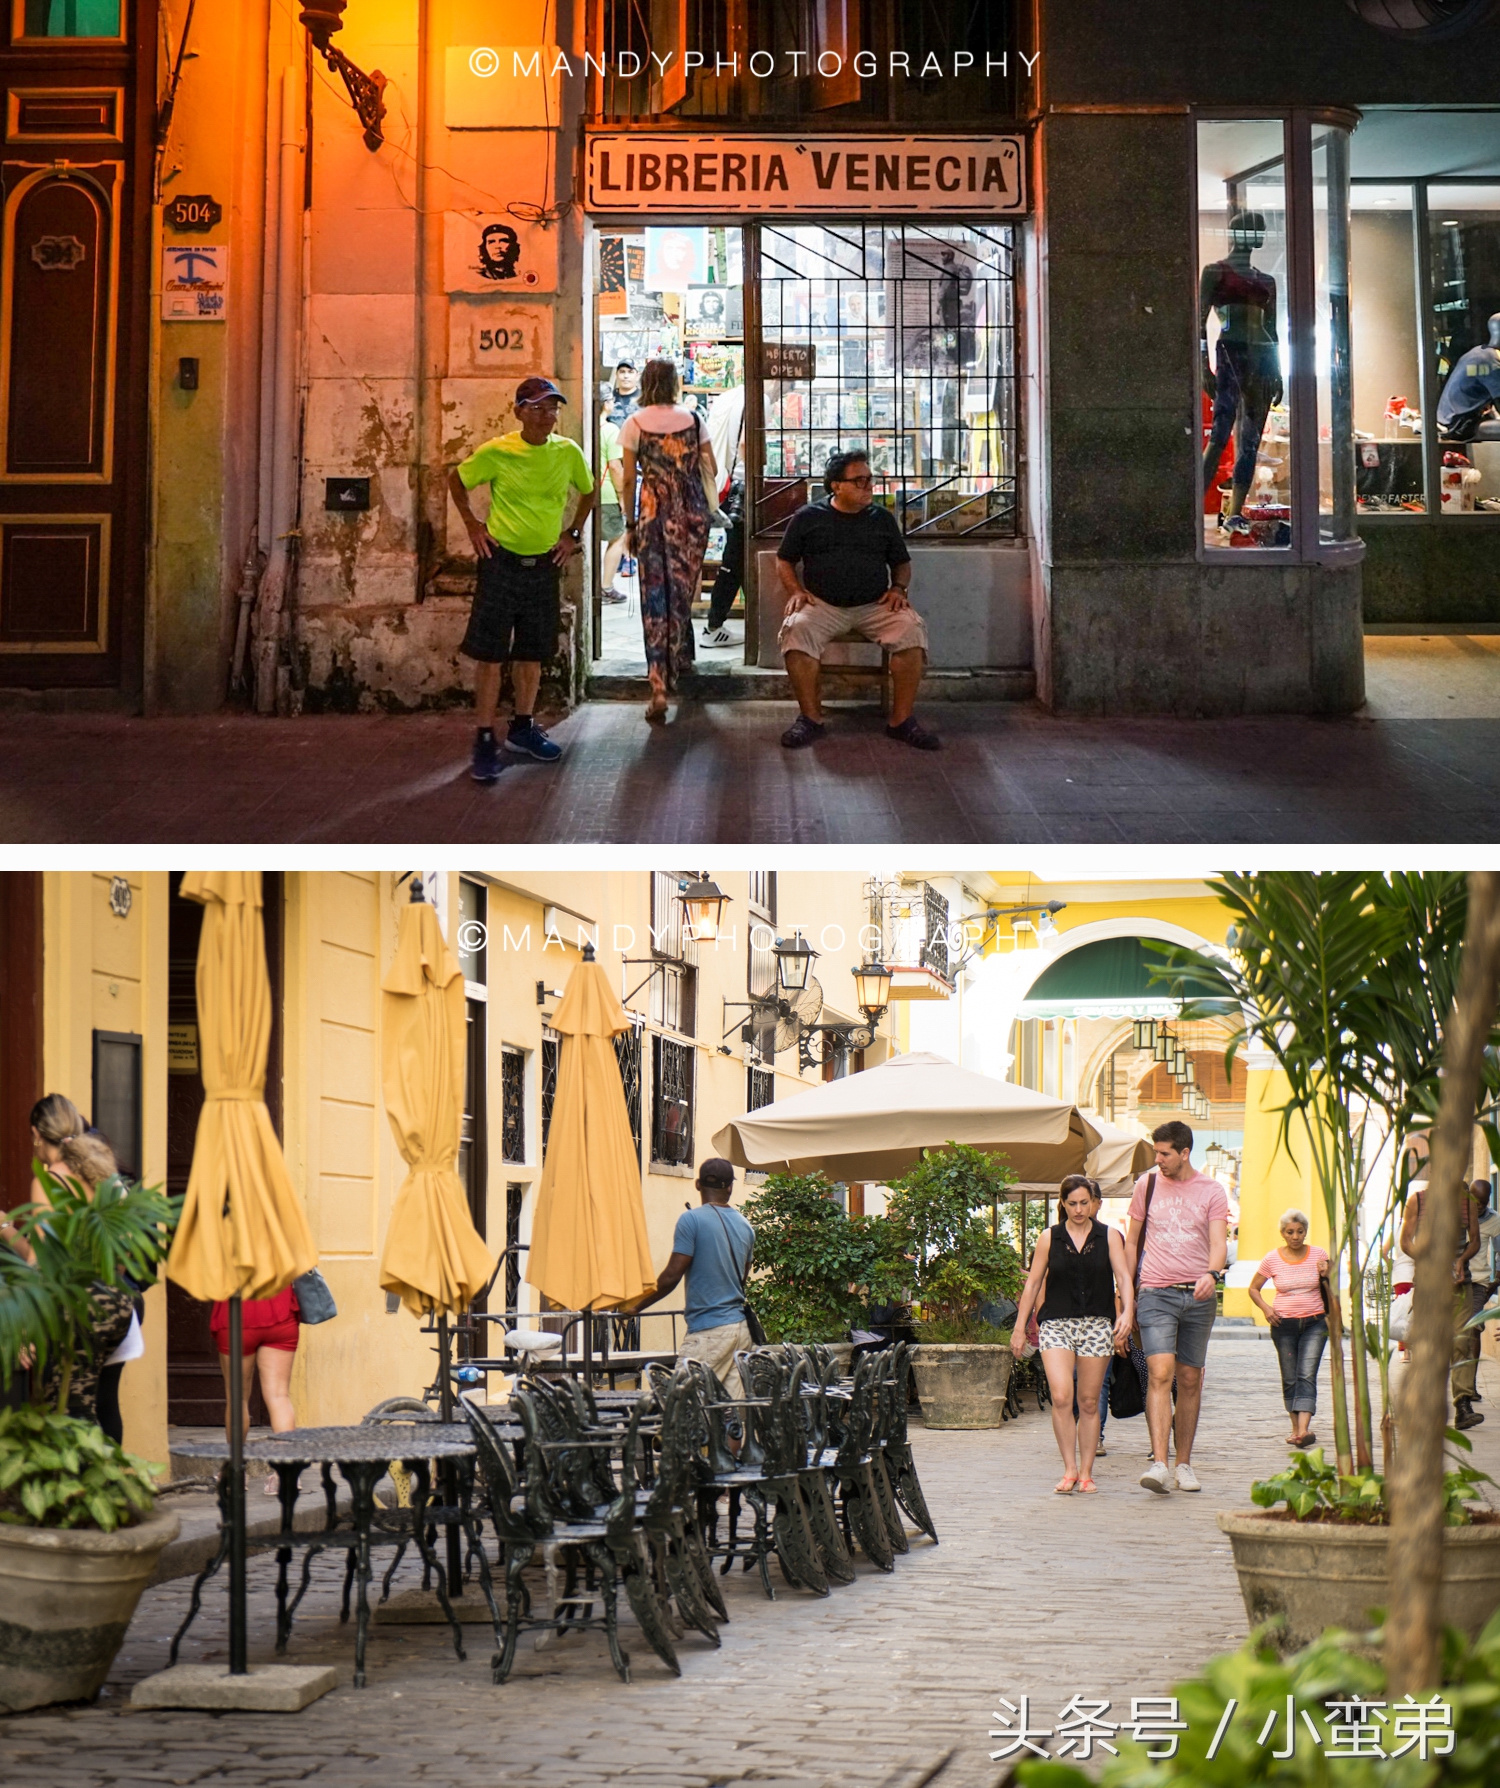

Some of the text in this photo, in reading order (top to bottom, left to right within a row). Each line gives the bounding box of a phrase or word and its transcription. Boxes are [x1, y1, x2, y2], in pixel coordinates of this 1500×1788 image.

[601, 154, 788, 192] LIBRERIA
[176, 203, 211, 223] 504
[479, 328, 524, 351] 502
[1072, 1006, 1134, 1016] CERVEZAS
[1135, 1005, 1145, 1015] Y
